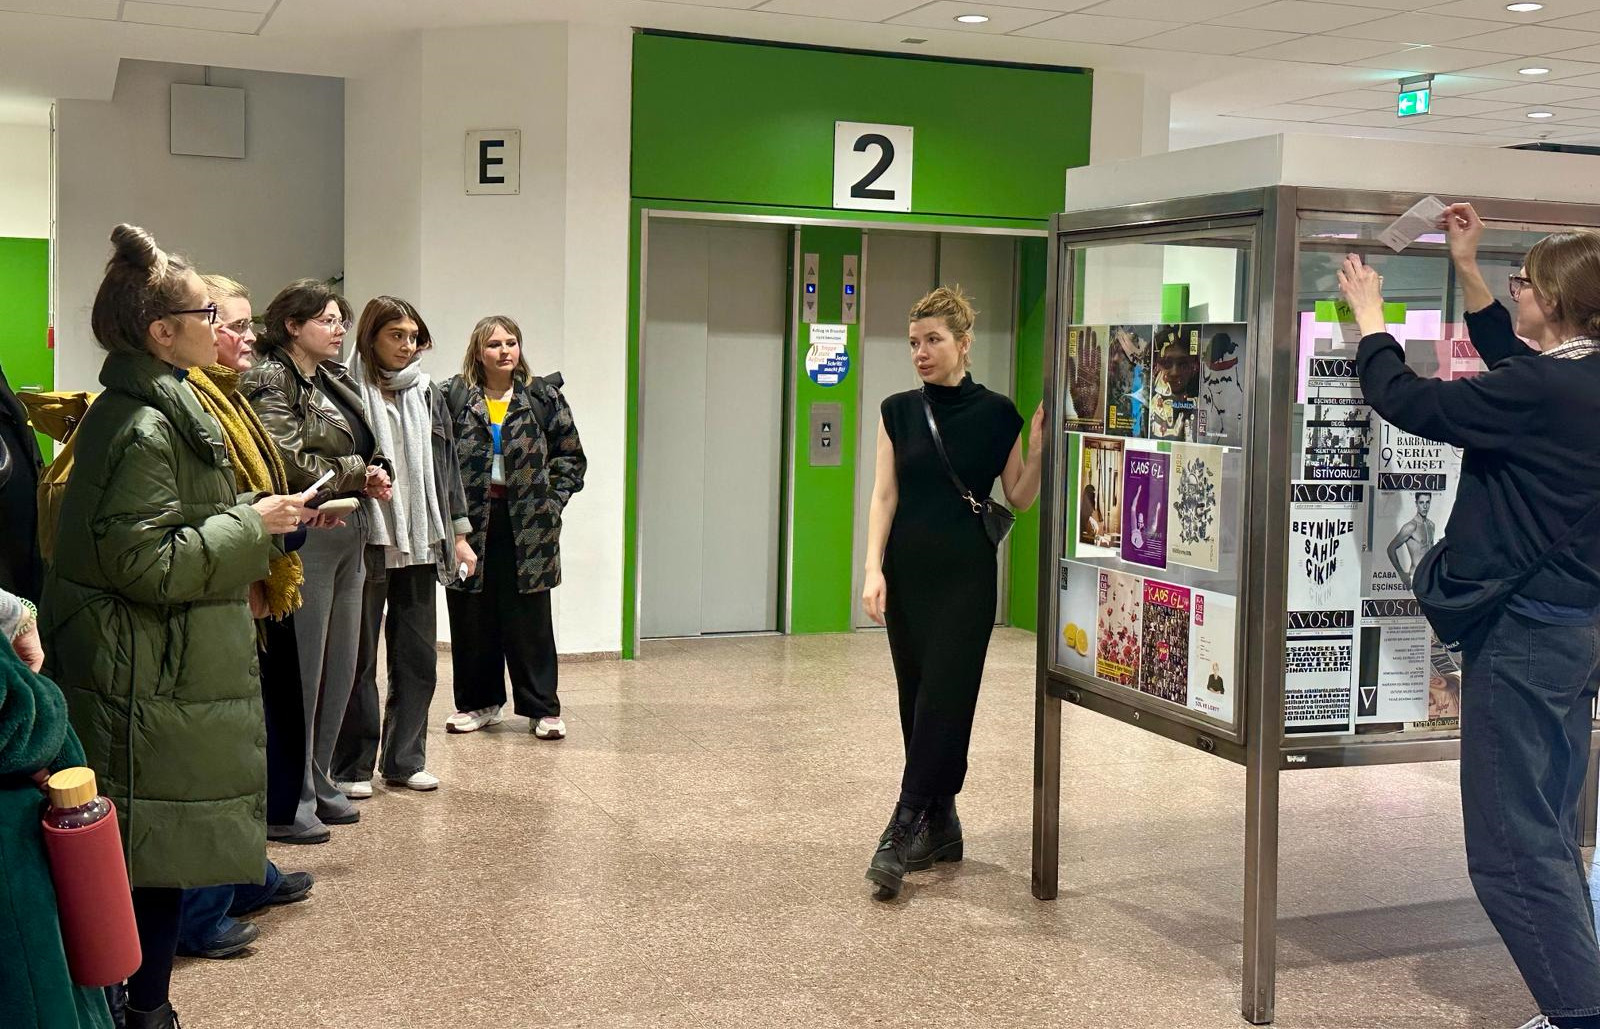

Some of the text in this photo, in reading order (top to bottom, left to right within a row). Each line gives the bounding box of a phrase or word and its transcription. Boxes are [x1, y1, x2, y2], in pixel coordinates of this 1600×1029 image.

[479, 140, 505, 184] E
[850, 133, 896, 200] 2
[1397, 447, 1442, 460] ŞERİAT
[1130, 460, 1164, 478] KAOS GL
[1313, 467, 1361, 479] İSTİYORUZ!
[1397, 460, 1445, 472] VAHŞET
[1292, 519, 1354, 540] BEYNİNİZE
[1305, 538, 1340, 563] SAHİP
[1305, 557, 1337, 585] ÇIKIN
[1373, 571, 1397, 579] ACABA
[1147, 585, 1184, 609] KAOS GL
